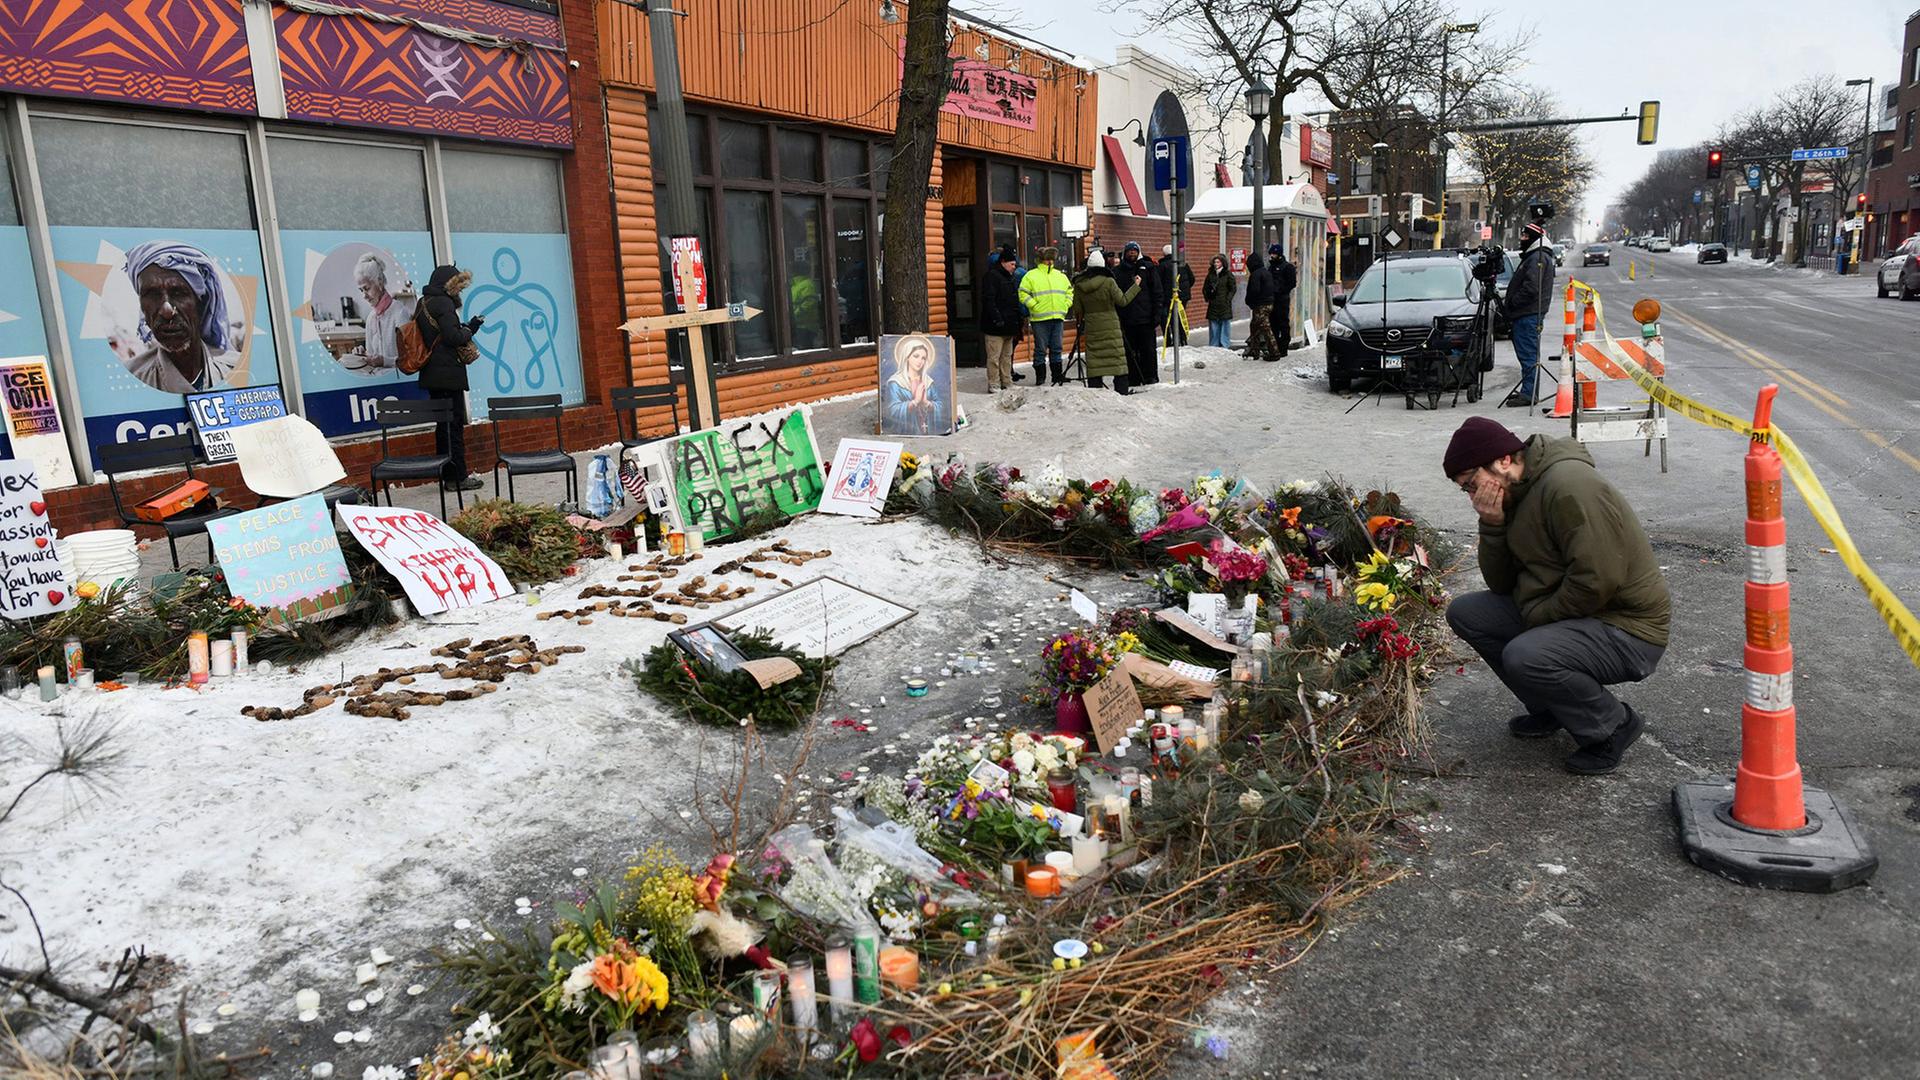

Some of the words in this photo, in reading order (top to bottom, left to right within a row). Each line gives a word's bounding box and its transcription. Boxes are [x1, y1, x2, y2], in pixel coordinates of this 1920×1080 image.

[1812, 150, 1833, 158] 26th
[1836, 149, 1845, 157] St
[672, 237, 697, 251] SHUT
[3, 371, 44, 388] ICE
[8, 386, 50, 410] OUT!
[190, 396, 230, 427] ICE
[234, 390, 280, 405] AMERICAN
[238, 404, 280, 421] GESTAPO
[684, 418, 795, 481] ALEX
[240, 504, 305, 534] PEACE
[220, 535, 281, 564] STEMS
[288, 535, 339, 561] FROM
[0, 569, 30, 590] You
[27, 567, 64, 585] have
[253, 562, 329, 597] JUSTICE
[9, 588, 39, 610] For
